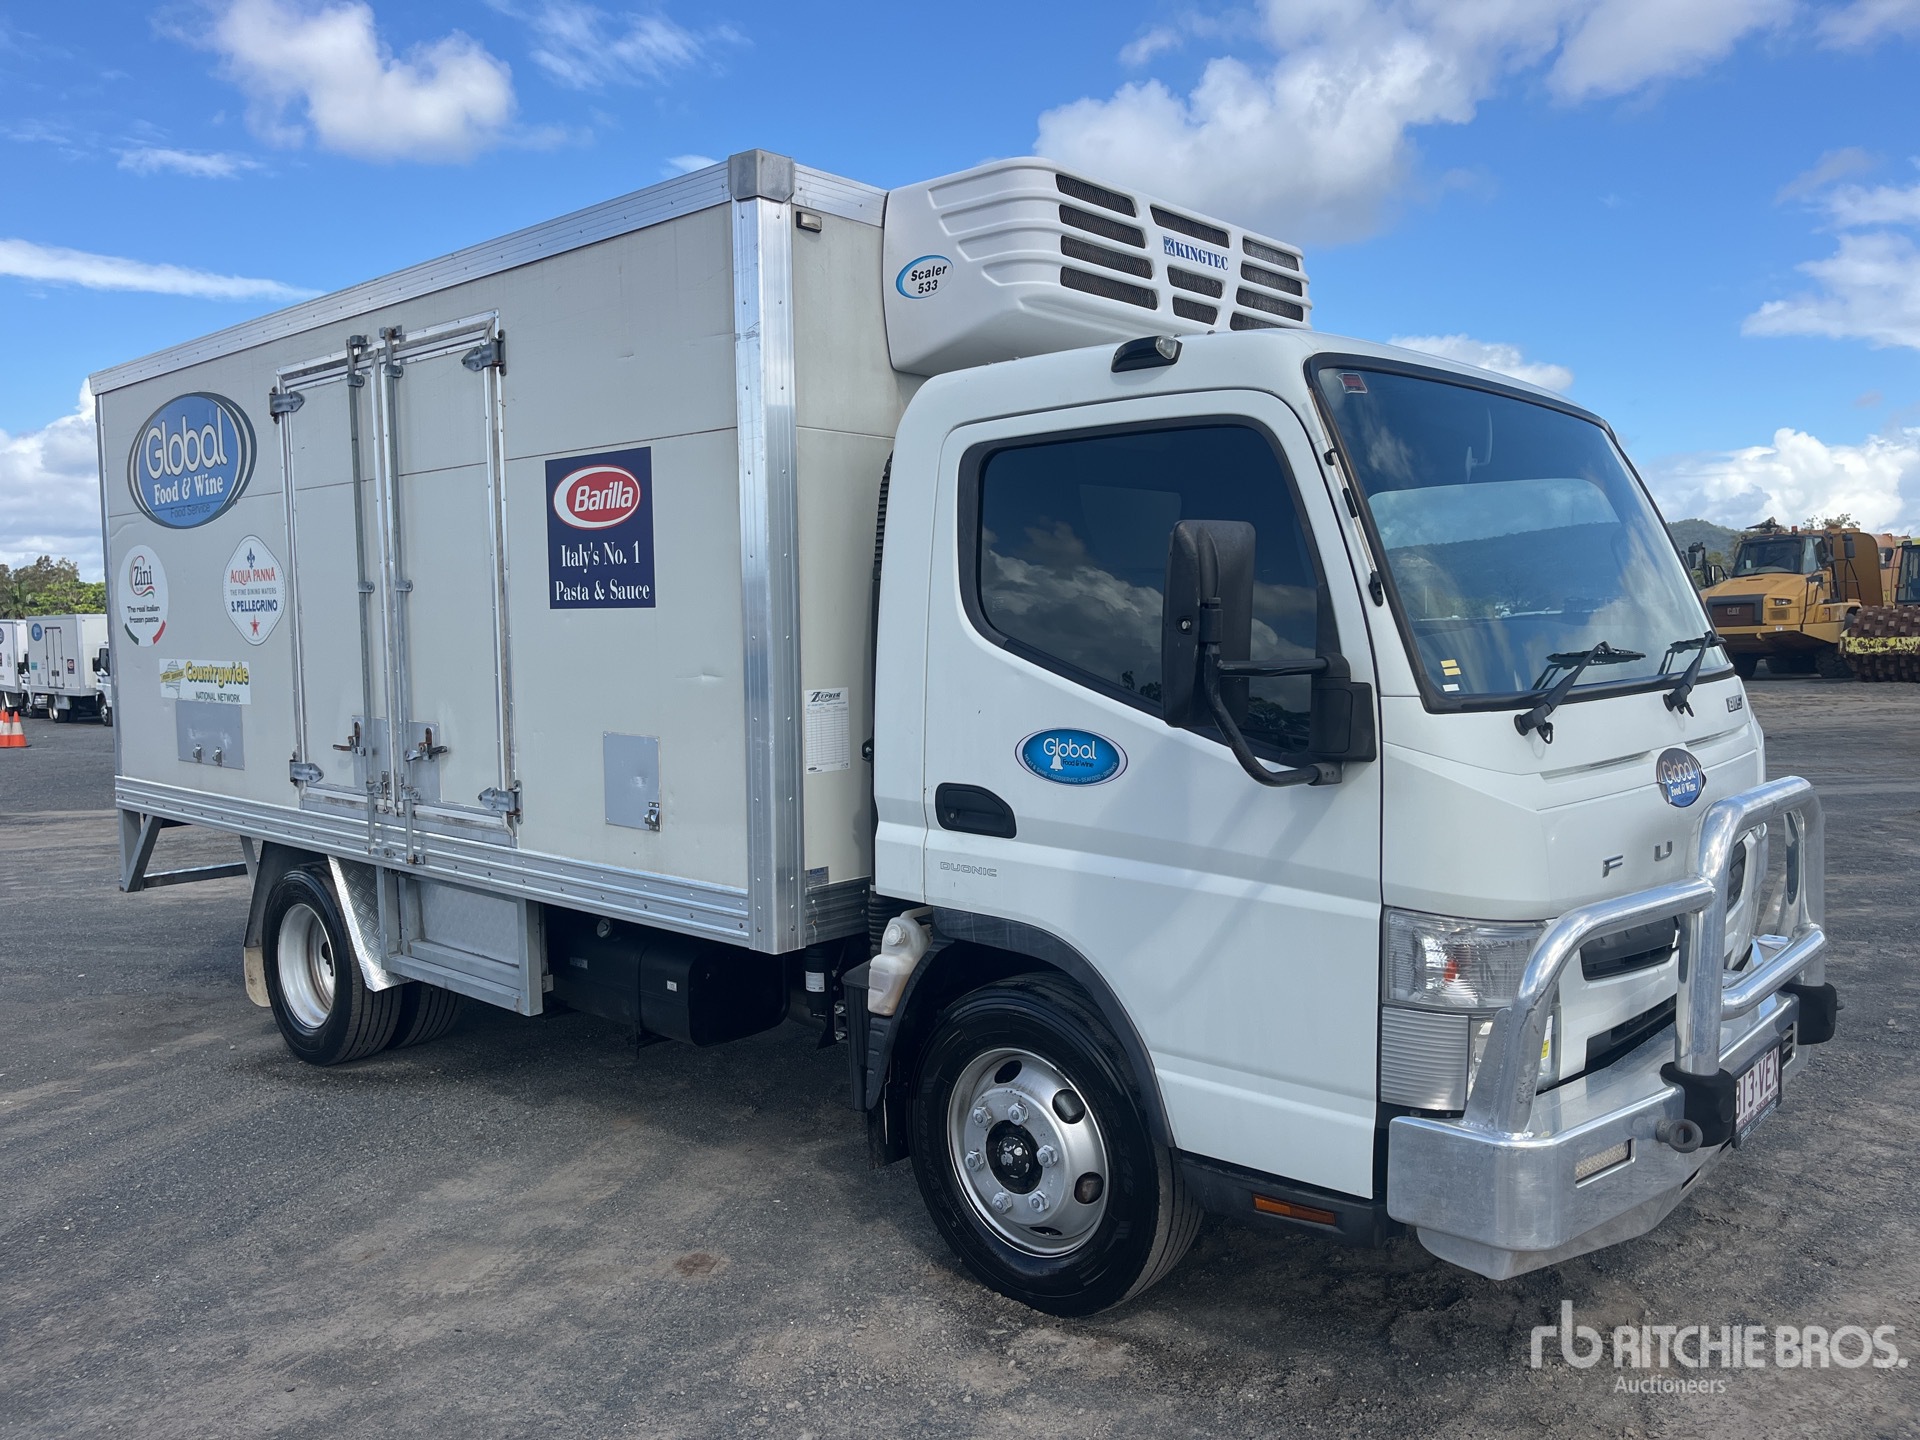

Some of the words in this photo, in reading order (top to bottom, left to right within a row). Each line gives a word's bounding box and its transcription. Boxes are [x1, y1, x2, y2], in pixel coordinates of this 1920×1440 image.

[1175, 241, 1229, 271] KINGTEC
[911, 265, 947, 282] Scaler
[917, 279, 938, 294] 533
[145, 406, 228, 479] Global
[154, 480, 179, 506] Food
[181, 477, 191, 500] &
[194, 473, 224, 497] Wine
[574, 480, 634, 512] Barilla
[170, 505, 186, 519] Food
[187, 503, 211, 516] Service
[560, 542, 600, 574] Italy's
[603, 541, 628, 566] No.
[632, 540, 641, 564] 1
[133, 565, 153, 586] Zini
[230, 569, 252, 586] ACQUA
[253, 567, 276, 582] PANNA
[230, 588, 238, 596] THE
[261, 587, 277, 595] WATERS
[555, 580, 590, 601] Pasta
[594, 580, 605, 601] &
[609, 578, 651, 601] Sauce
[127, 605, 136, 613] The
[136, 605, 146, 613] real
[1726, 607, 1740, 616] CAT
[185, 660, 250, 689] Countrywide
[195, 691, 217, 701] NATIONAL
[217, 692, 241, 703] NETWORK
[1043, 738, 1097, 760] Global
[1062, 759, 1075, 767] Food
[1661, 755, 1697, 785] Global
[1670, 784, 1682, 797] Food
[1685, 781, 1697, 792] Wine
[940, 861, 998, 878] DUONIC
